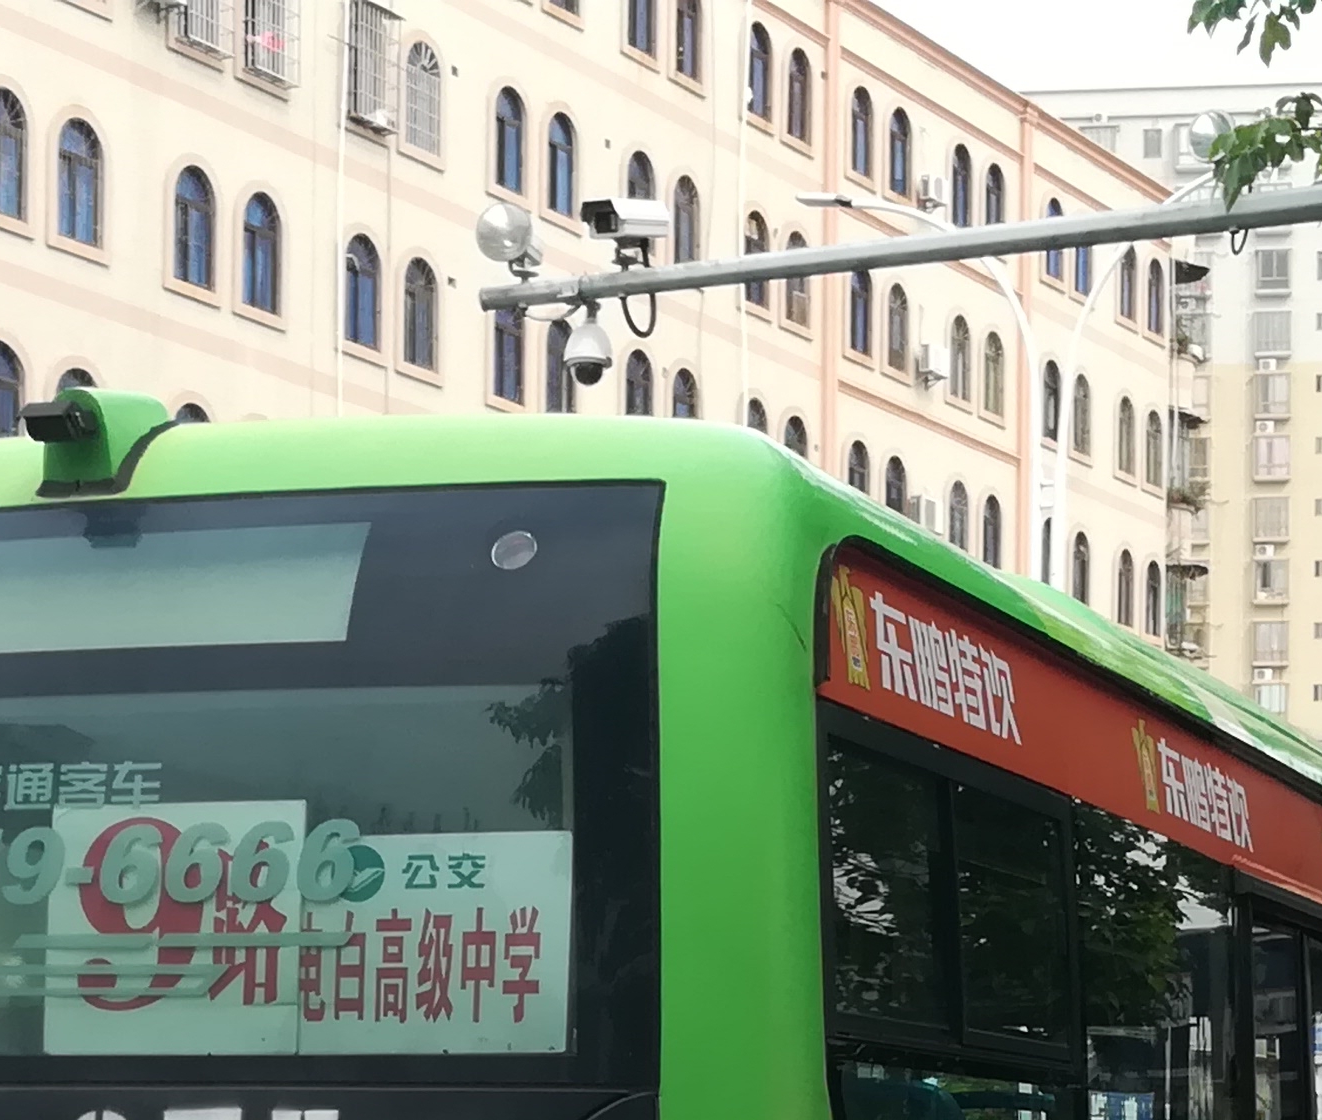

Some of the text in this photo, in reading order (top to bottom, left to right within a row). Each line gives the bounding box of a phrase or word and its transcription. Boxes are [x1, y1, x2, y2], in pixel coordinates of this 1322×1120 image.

[869, 591, 1022, 745] 东鹏特饮
[1157, 737, 1254, 853] 东鹏特饮
[402, 853, 486, 890] 公交
